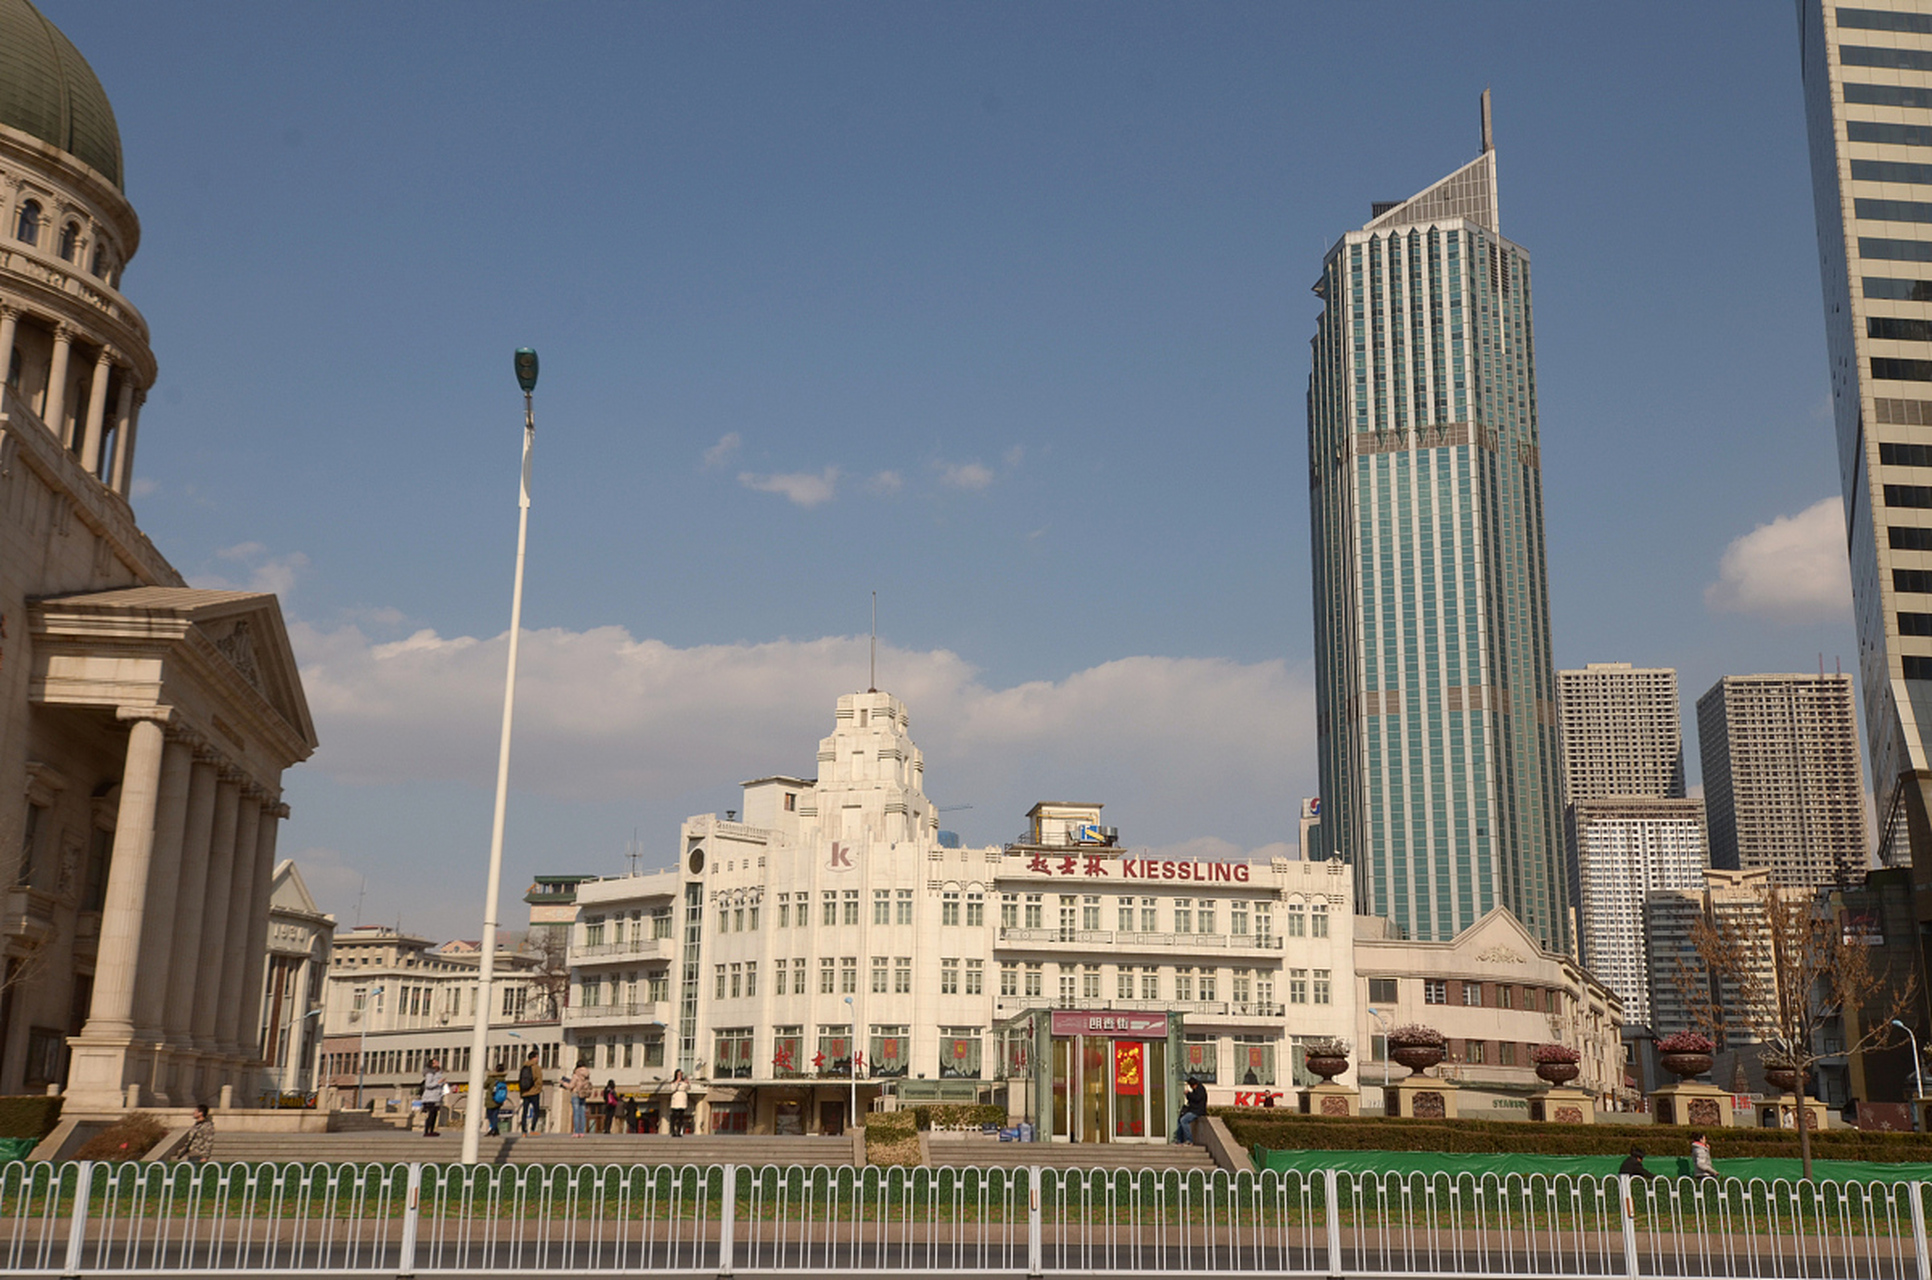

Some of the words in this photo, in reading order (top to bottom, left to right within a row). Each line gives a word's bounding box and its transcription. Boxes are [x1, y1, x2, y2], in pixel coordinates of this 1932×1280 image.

[1026, 852, 1109, 877] 起士林
[1122, 859, 1250, 882] KIESSLING
